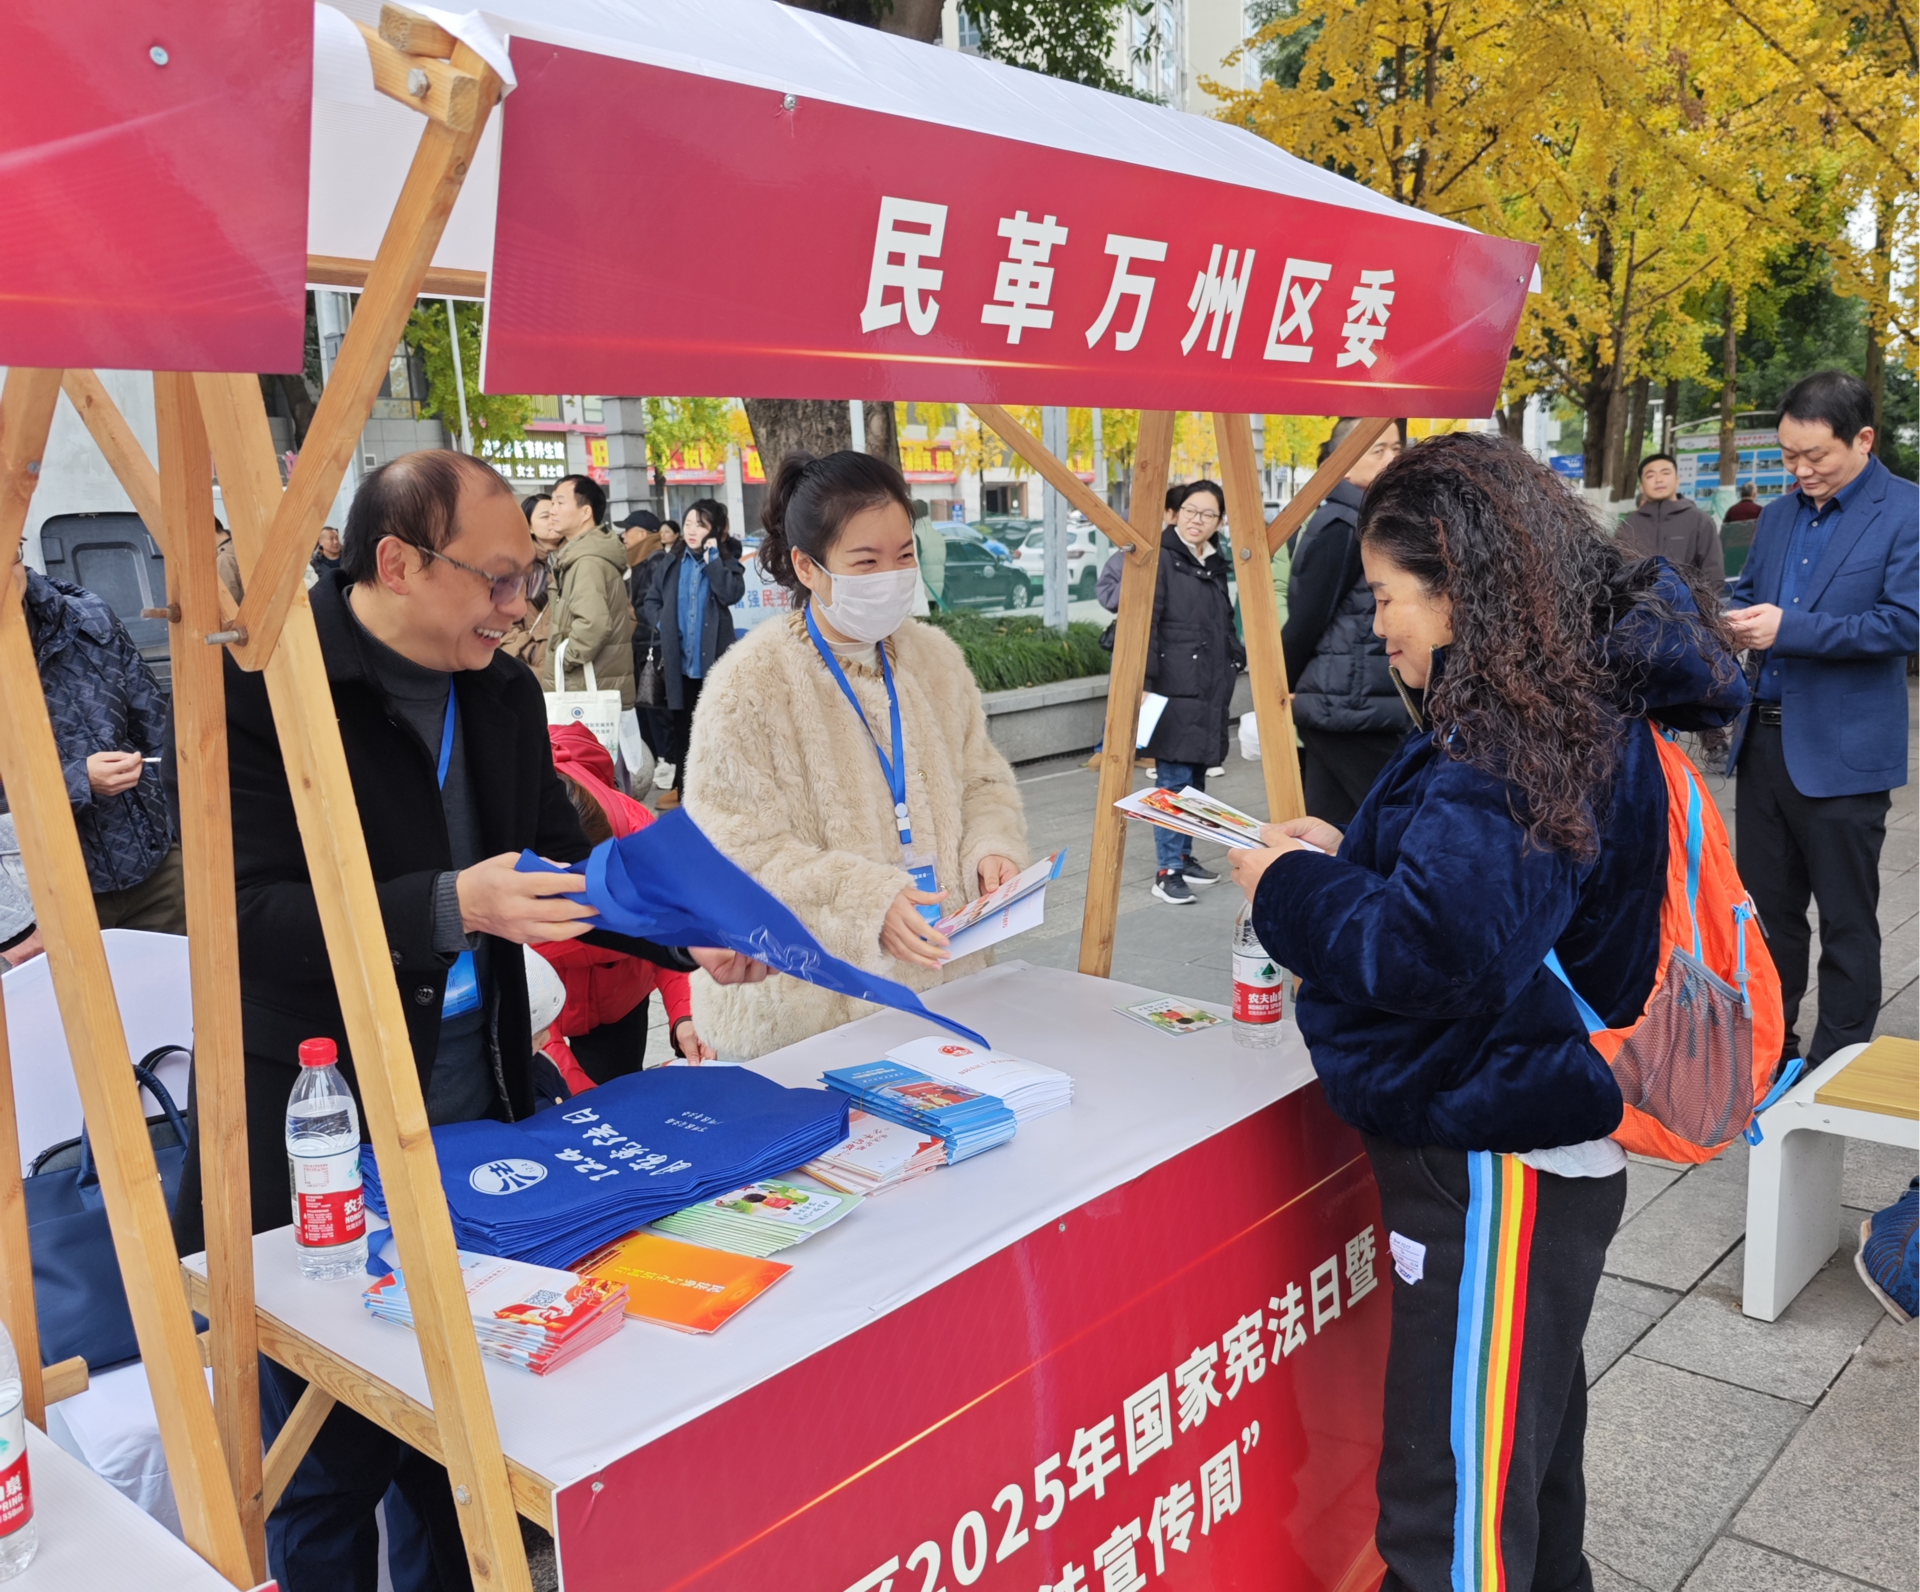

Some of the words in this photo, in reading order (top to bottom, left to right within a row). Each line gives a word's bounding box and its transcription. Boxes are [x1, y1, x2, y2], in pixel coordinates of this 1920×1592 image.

[859, 195, 1396, 369] 民革万州区委
[516, 463, 535, 477] 女士
[561, 1107, 693, 1176] 国家宪法日
[554, 1147, 620, 1182] 12.4
[614, 1266, 726, 1293] 民法典与生活同行
